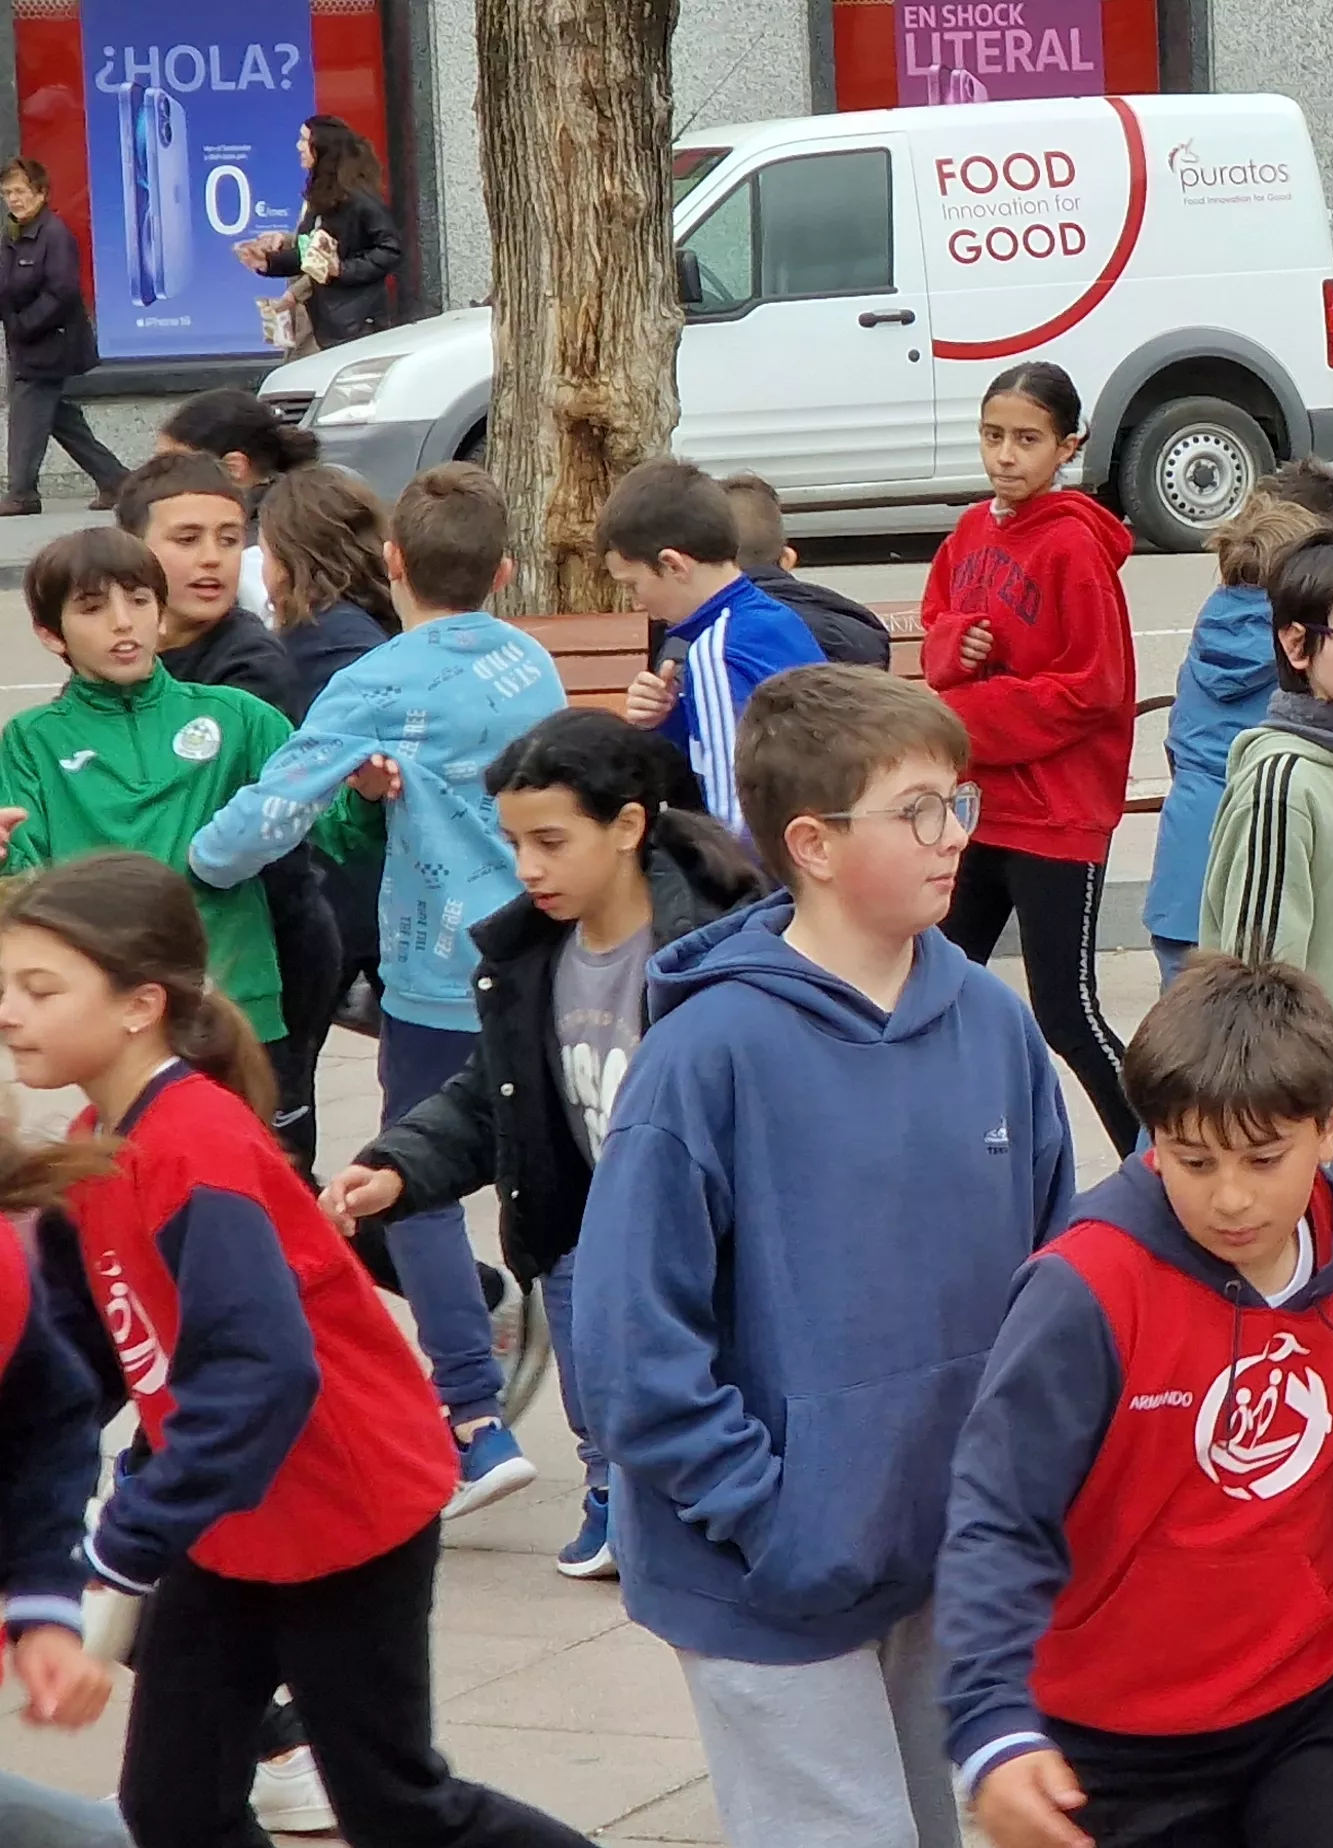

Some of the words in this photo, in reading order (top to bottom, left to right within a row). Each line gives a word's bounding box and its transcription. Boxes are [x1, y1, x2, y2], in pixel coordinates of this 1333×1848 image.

[904, 6, 936, 28] EN
[942, 3, 1024, 27] SHOCK
[95, 44, 299, 92] ¿HOLA?
[905, 27, 1094, 76] LITERAL
[935, 150, 1076, 196] FOOD
[1180, 159, 1290, 194] puratos
[205, 165, 250, 235] 0
[942, 197, 1049, 221] Innovation
[1054, 194, 1080, 212] for
[948, 222, 1086, 264] GOOD
